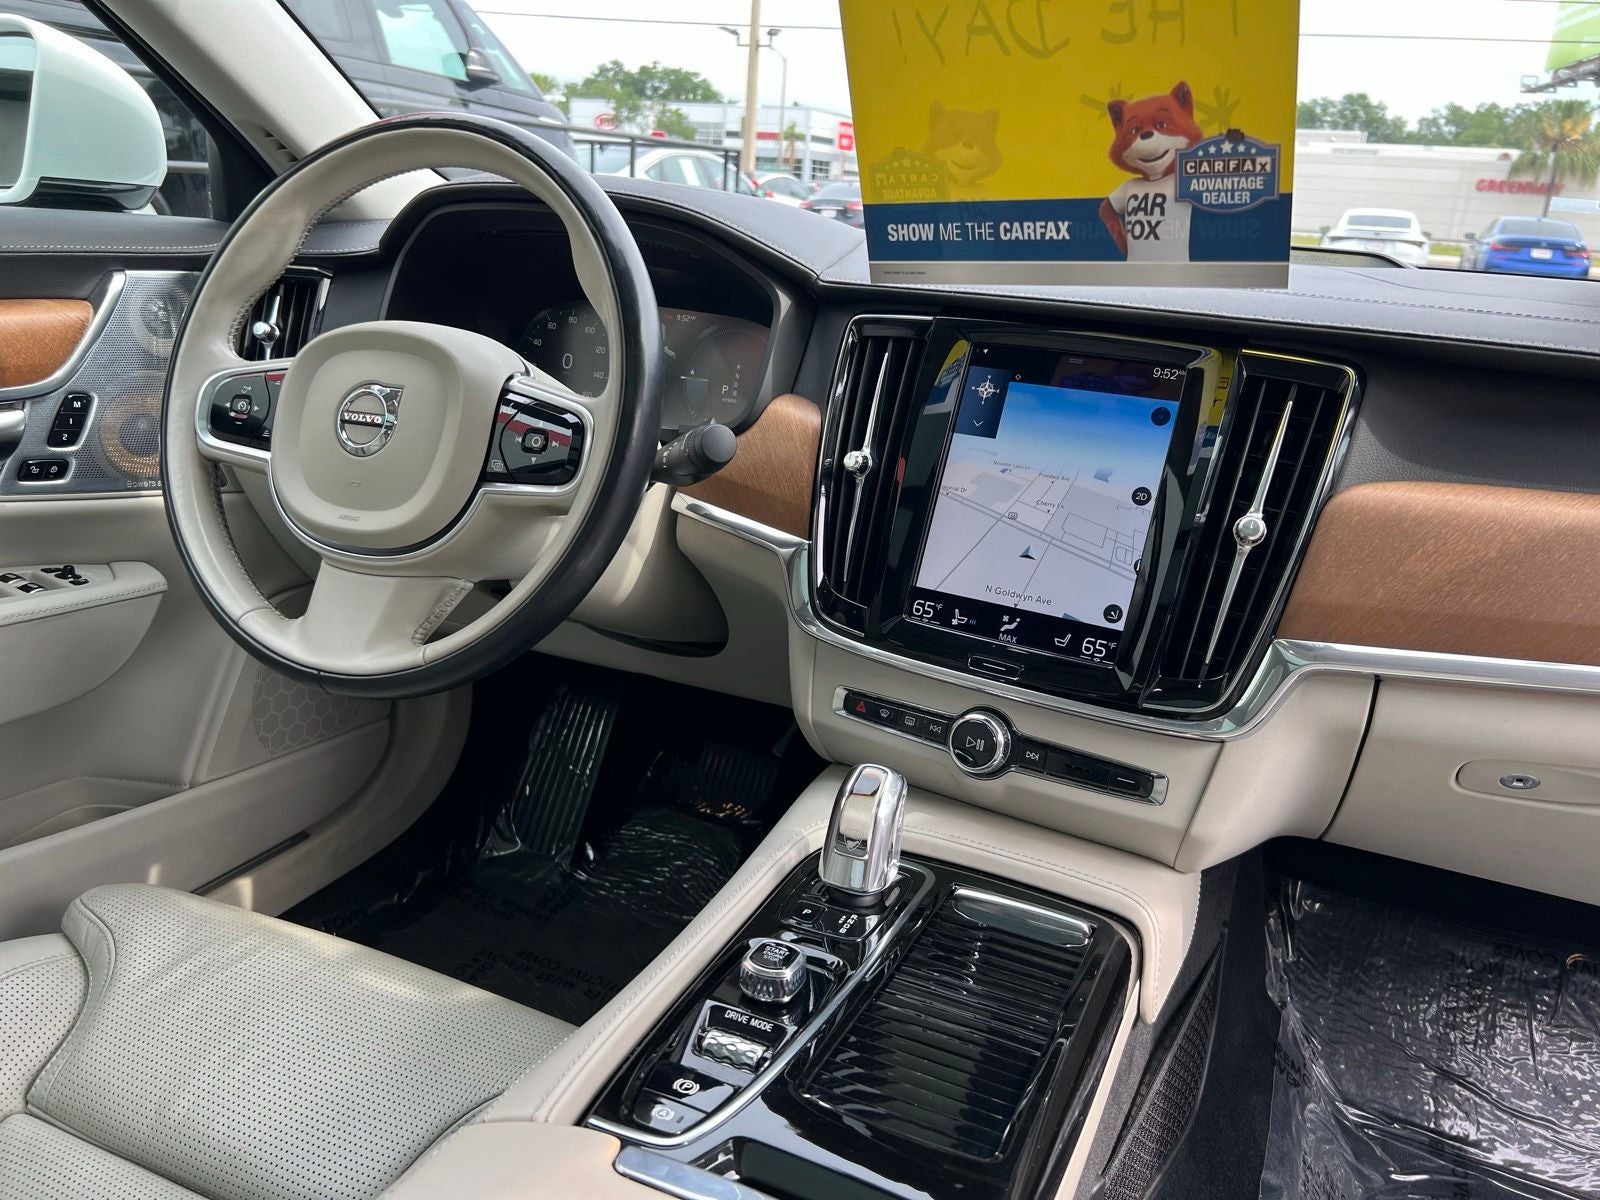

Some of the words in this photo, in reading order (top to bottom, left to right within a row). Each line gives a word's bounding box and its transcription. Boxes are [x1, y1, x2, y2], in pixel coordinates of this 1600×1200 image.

[1186, 158, 1270, 174] CARFAX
[1190, 176, 1264, 192] ADVANTAGE
[1126, 192, 1167, 217] CAR
[1202, 191, 1250, 205] DEALER
[887, 223, 934, 242] SHOW
[939, 222, 962, 241] ME
[965, 222, 995, 241] THE
[1000, 221, 1071, 241] CARFAX
[562, 353, 573, 369] 0
[1152, 367, 1179, 380] 9:52
[721, 384, 729, 395] P
[343, 412, 383, 424] VOLVO
[62, 433, 68, 441] 2
[1135, 492, 1148, 501] 2D
[985, 584, 992, 593] N
[994, 586, 1034, 603] Goldwyn
[1035, 595, 1052, 606] Ave
[998, 633, 1018, 644] MAX
[765, 946, 791, 956] START
[724, 1009, 749, 1025] DRIVE
[750, 1018, 774, 1032] MODE
